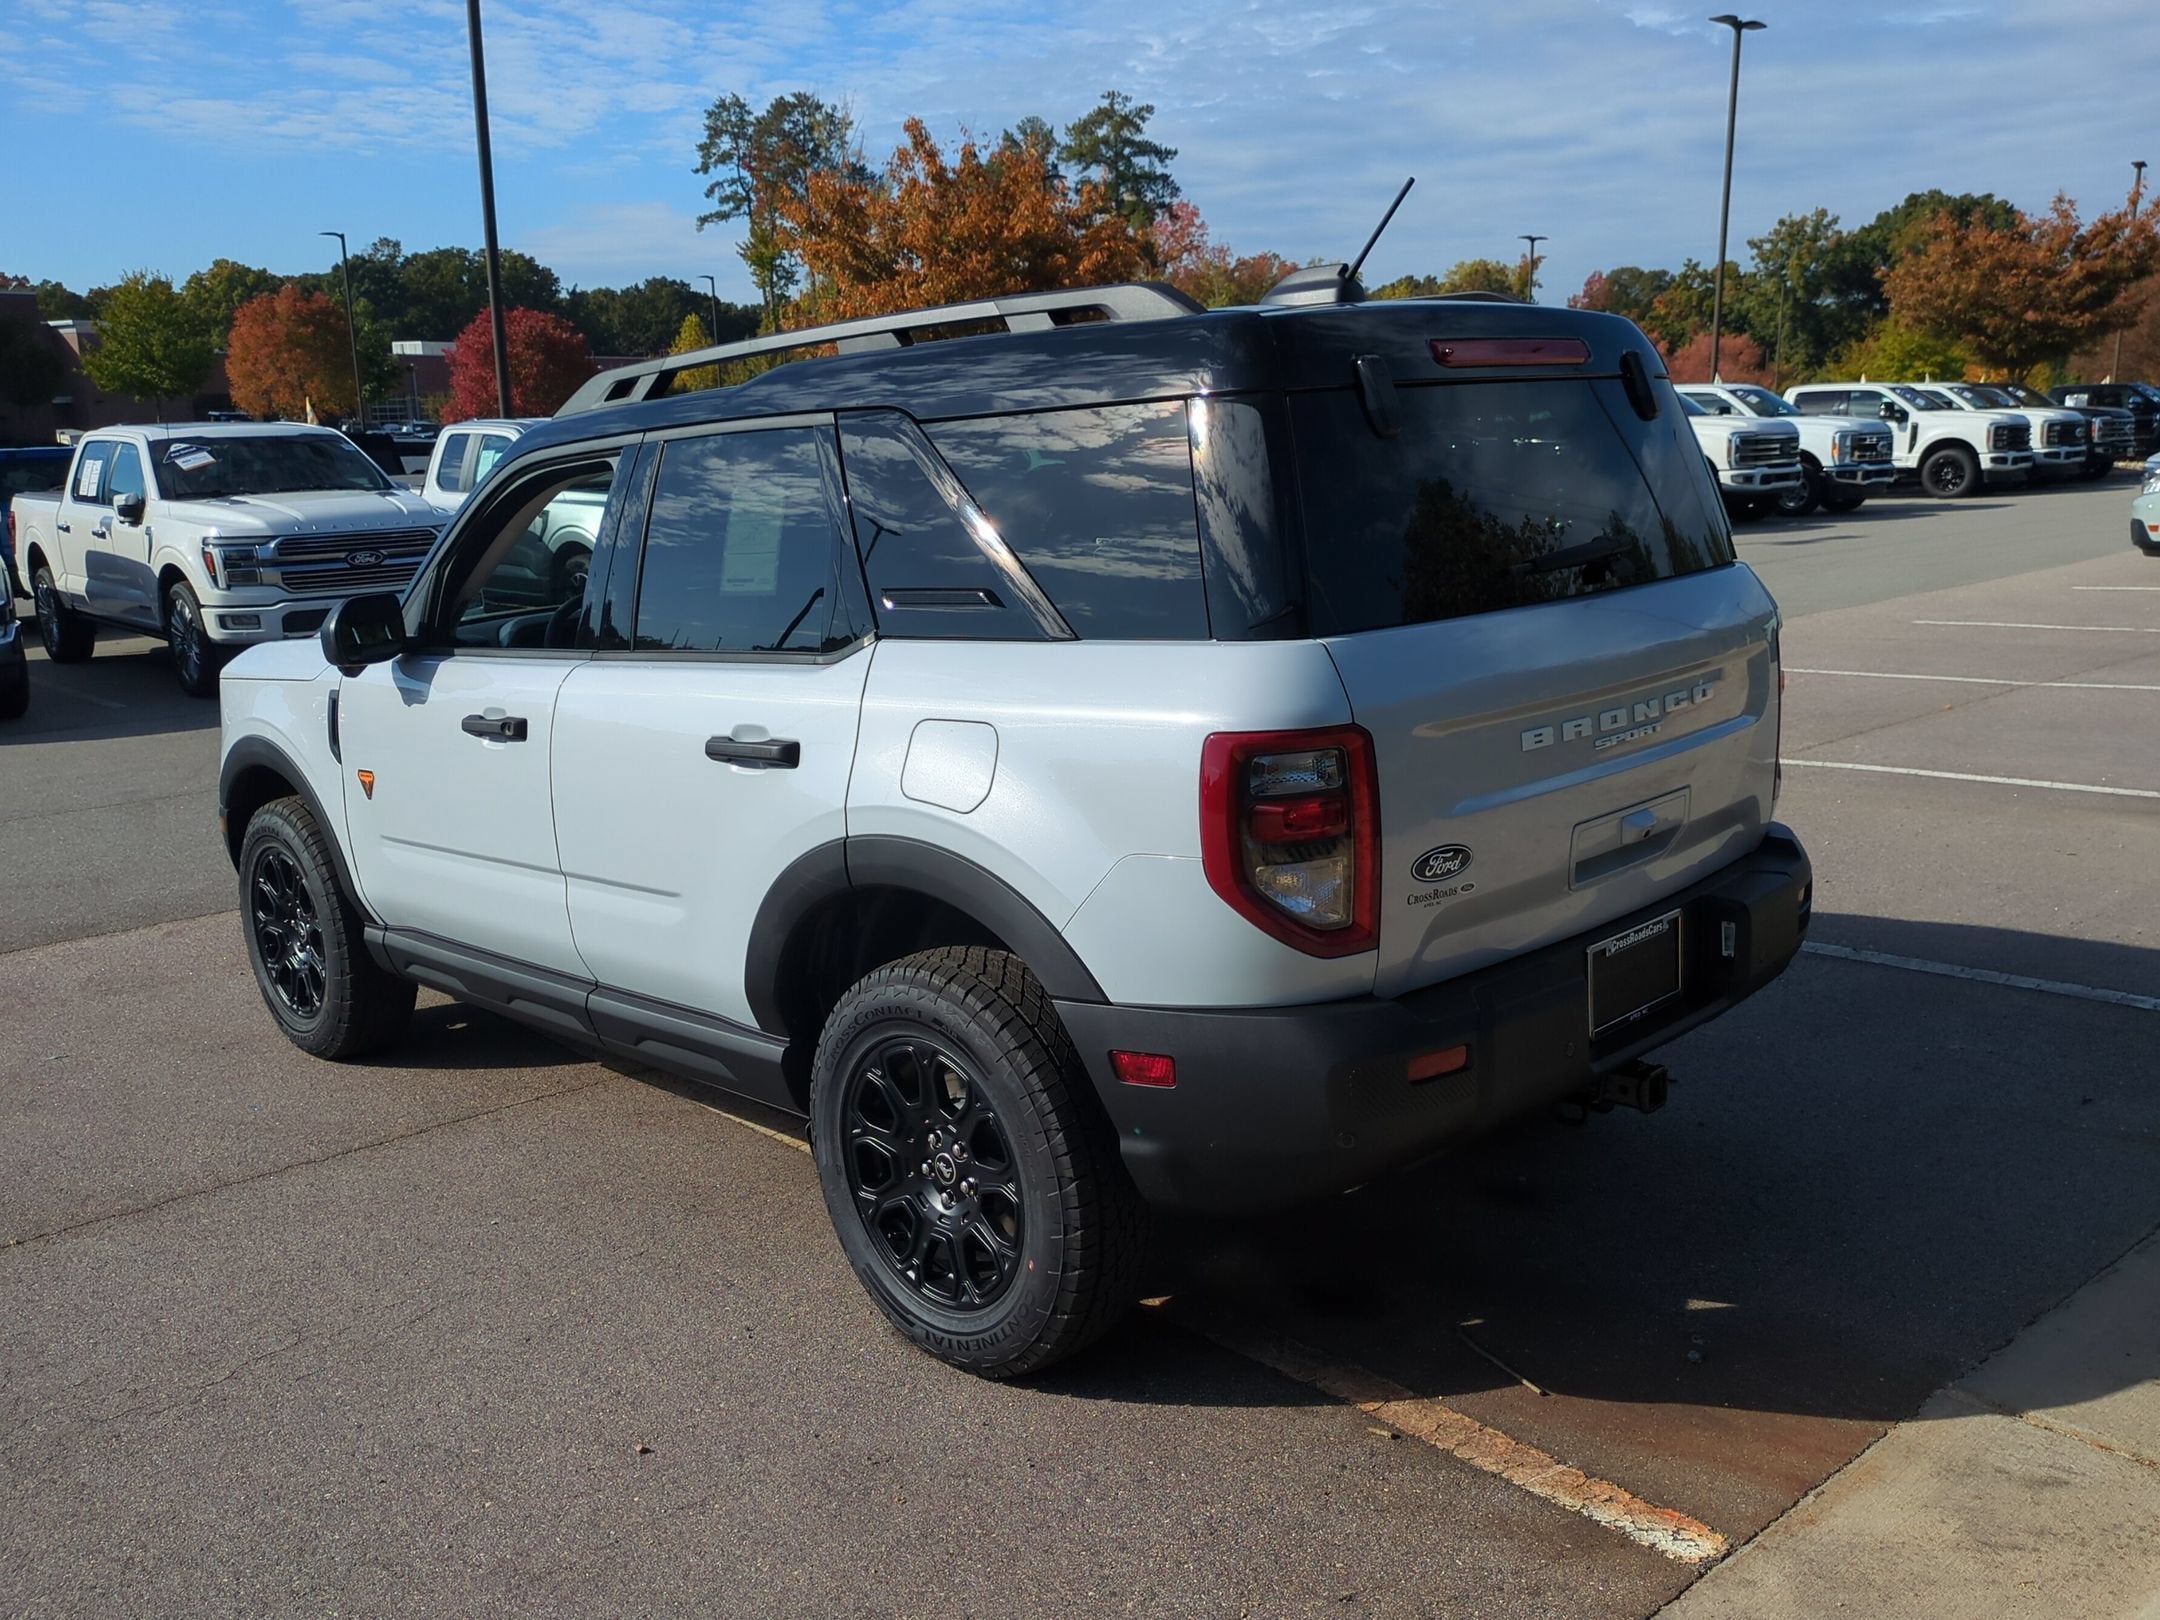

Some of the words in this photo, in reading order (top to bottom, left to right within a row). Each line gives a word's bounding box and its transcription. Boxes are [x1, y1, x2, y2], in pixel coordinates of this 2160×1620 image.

[1521, 681, 1715, 752] BRONCO
[1594, 721, 1664, 751] SPORT
[919, 1288, 1037, 1352] CONTINENTAL
